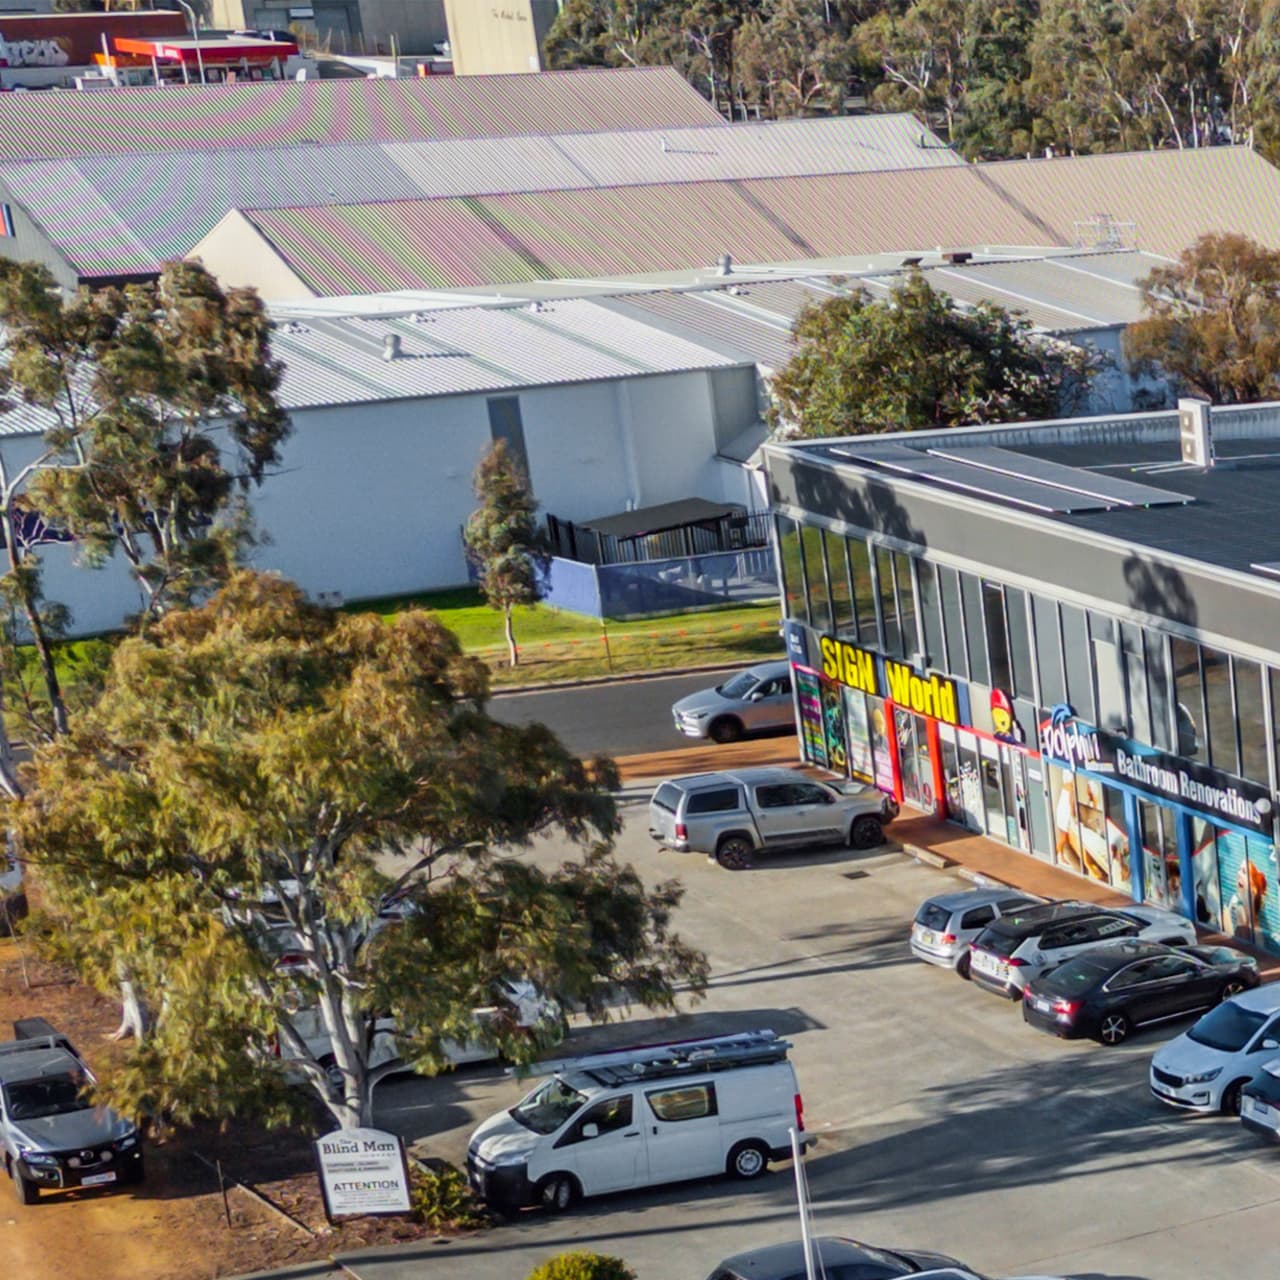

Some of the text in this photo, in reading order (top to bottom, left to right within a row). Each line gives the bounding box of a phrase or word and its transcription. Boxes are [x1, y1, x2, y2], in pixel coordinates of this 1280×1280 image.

[820, 637, 877, 697] SIGN
[887, 660, 957, 726] World
[1116, 749, 1262, 824] Bathroom Renovations
[323, 1141, 395, 1154] Blind Man
[334, 1180, 399, 1191] ATTENTION
